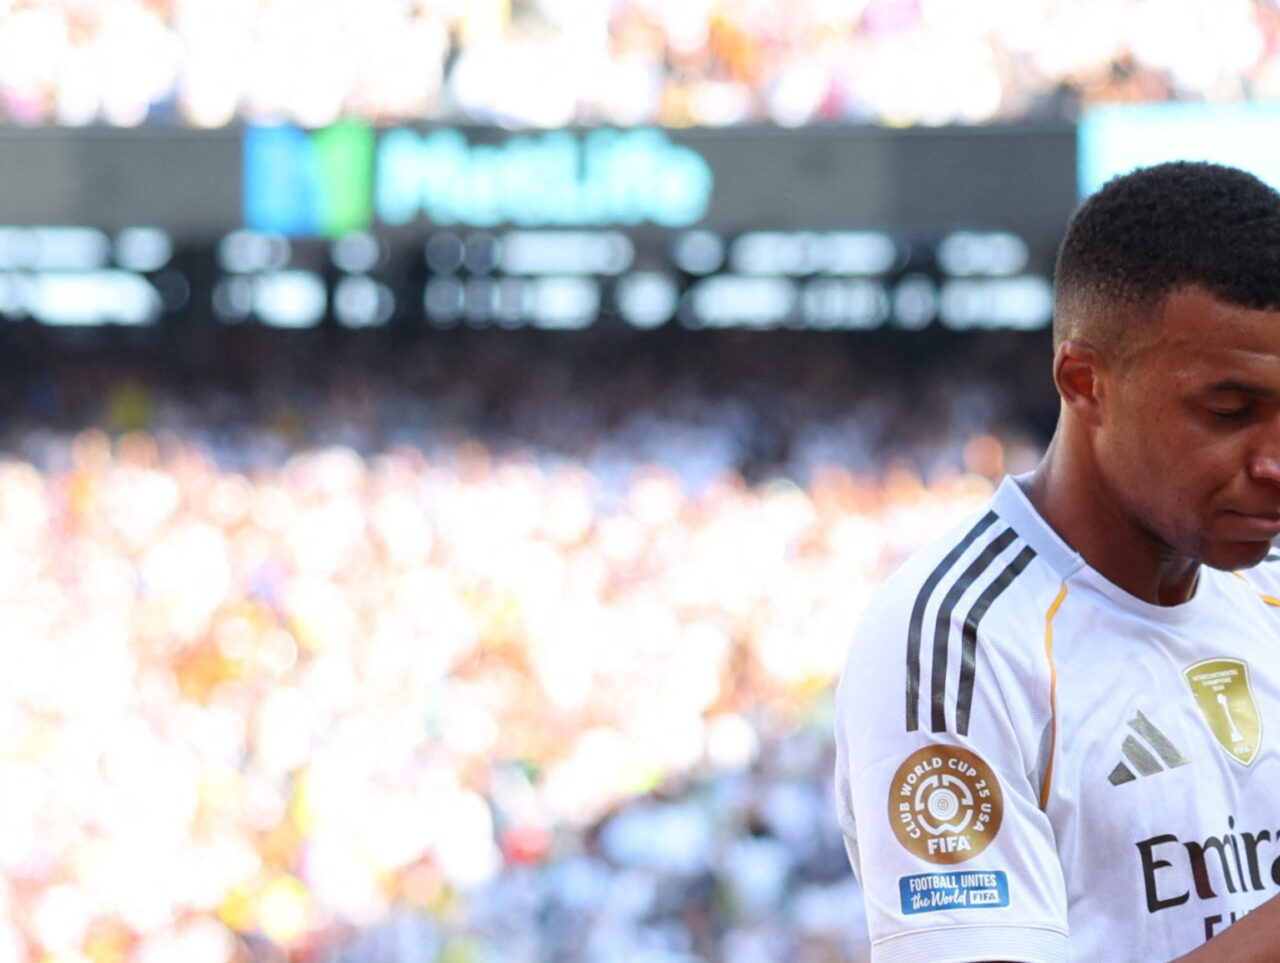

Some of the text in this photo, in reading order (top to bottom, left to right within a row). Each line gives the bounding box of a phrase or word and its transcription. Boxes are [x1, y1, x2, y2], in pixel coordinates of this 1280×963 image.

[900, 757, 992, 839] CLUB WORLD CUP 25 USA
[927, 835, 972, 855] FIFA
[909, 873, 997, 892] FOOTBALL UNITES
[911, 889, 967, 910] the World
[972, 892, 997, 902] FIFA
